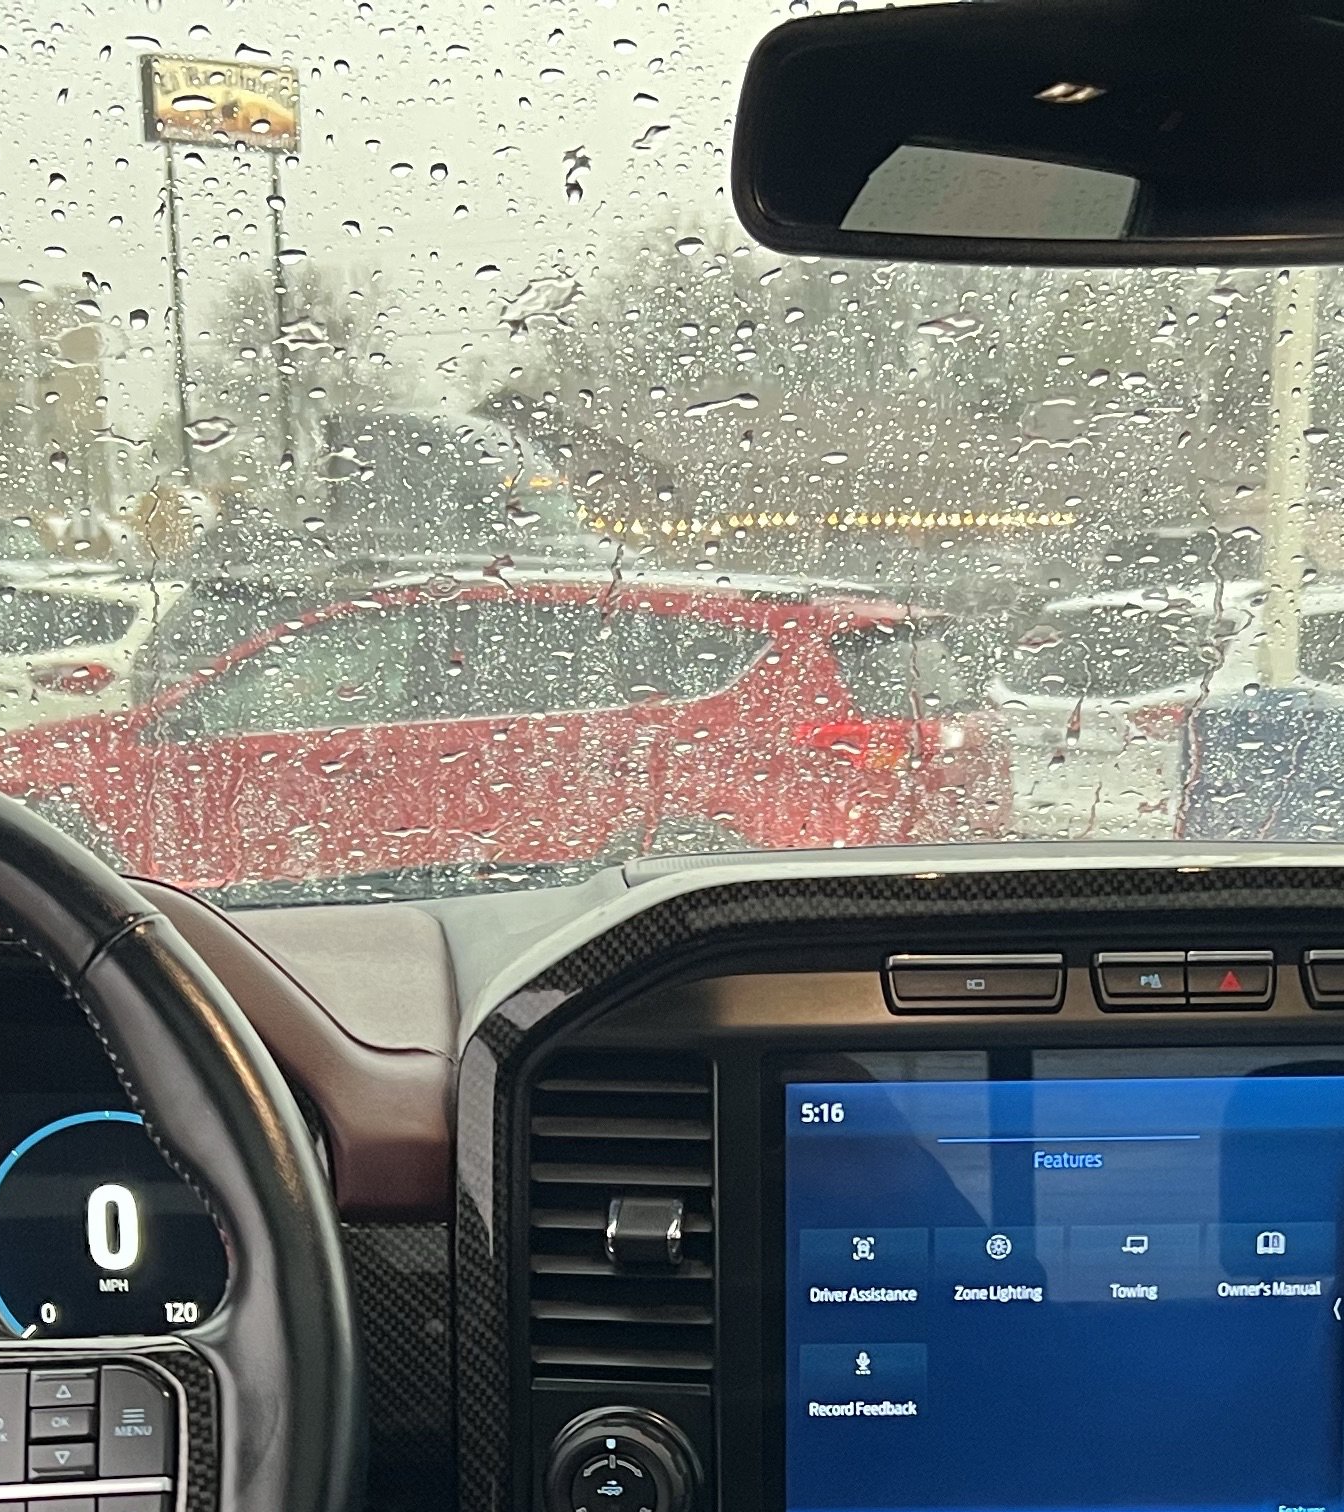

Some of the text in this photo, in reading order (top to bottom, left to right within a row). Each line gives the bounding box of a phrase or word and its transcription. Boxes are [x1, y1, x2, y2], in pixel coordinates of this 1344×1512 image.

[801, 1103, 844, 1122] 5:16
[1033, 1151, 1103, 1169] Features
[87, 1184, 139, 1270] 0
[98, 1278, 130, 1292] MPH
[954, 1284, 1043, 1304] Zone Lighting
[1109, 1282, 1158, 1302] Towing
[1217, 1280, 1321, 1297] Owner's Manual
[809, 1286, 918, 1303] Driver Assistance
[41, 1302, 57, 1324] 0
[164, 1302, 198, 1323] 120
[809, 1401, 917, 1417] Record Feedback
[50, 1416, 70, 1428] OK
[114, 1426, 153, 1437] MENU
